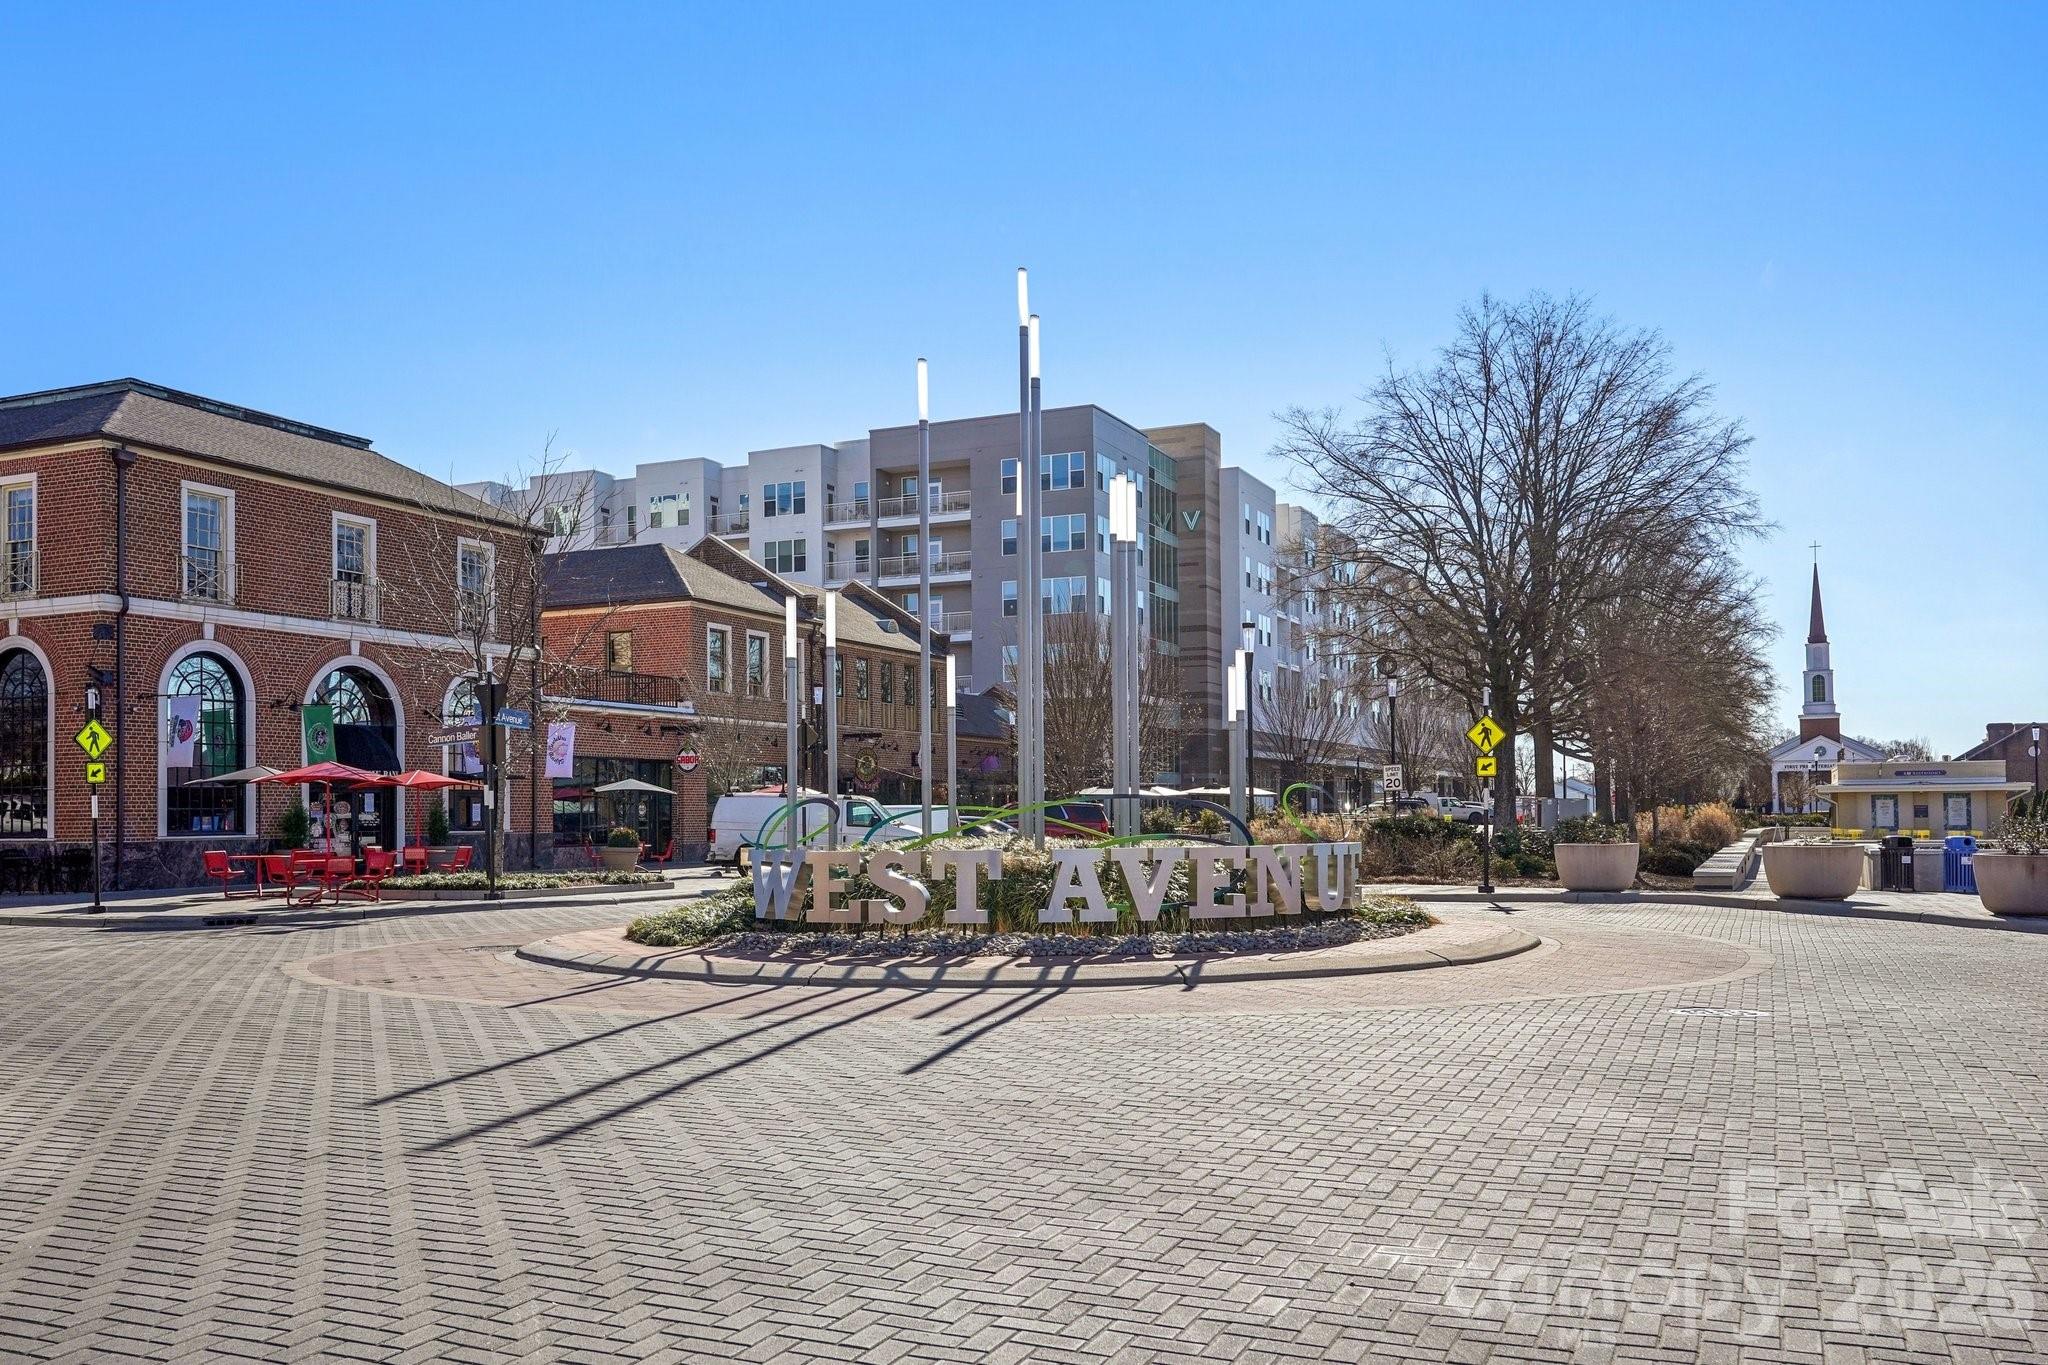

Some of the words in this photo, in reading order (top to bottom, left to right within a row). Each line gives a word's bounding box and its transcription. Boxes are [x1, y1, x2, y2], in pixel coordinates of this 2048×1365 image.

[501, 713, 523, 725] Avenue
[428, 734, 455, 744] Cannon
[456, 731, 477, 741] Baller
[676, 755, 700, 764] SABOR
[1385, 778, 1401, 788] 20
[751, 849, 1003, 924] WEST
